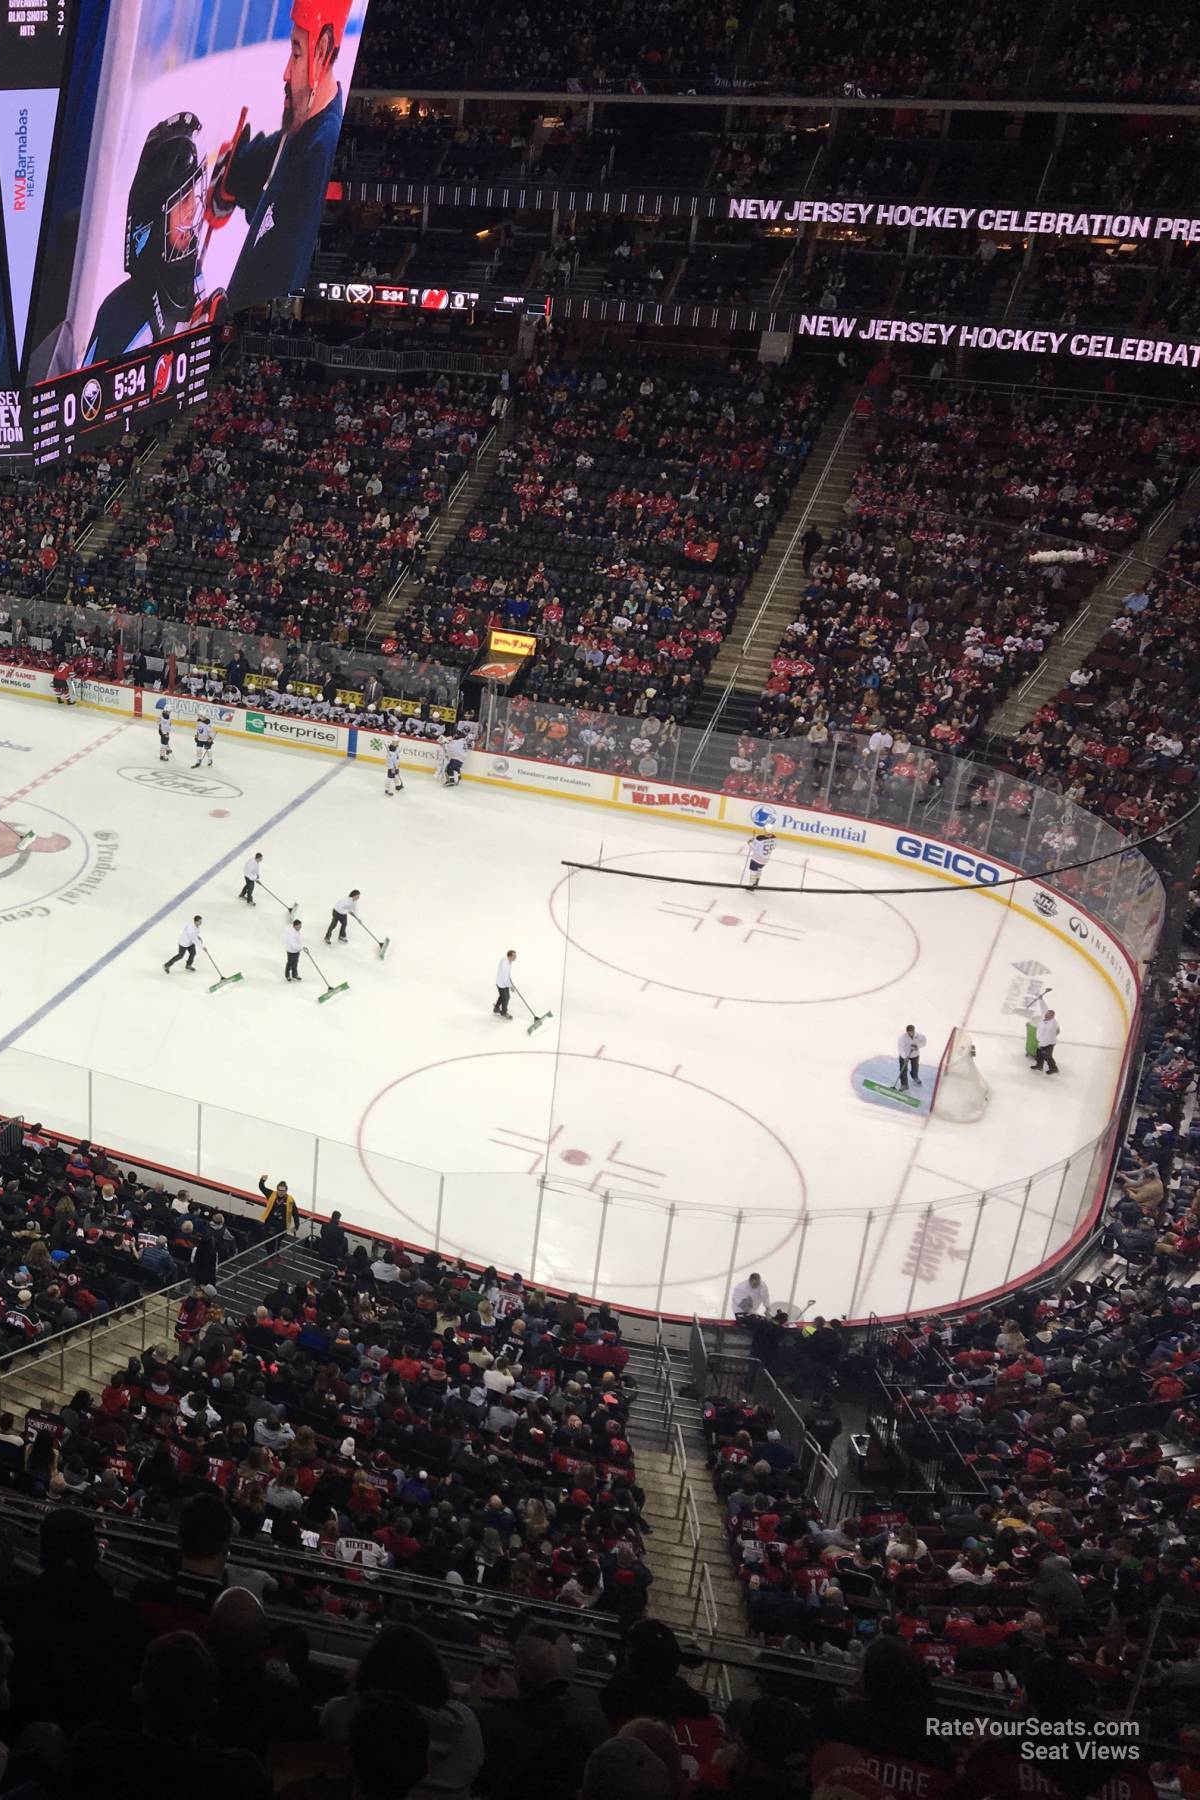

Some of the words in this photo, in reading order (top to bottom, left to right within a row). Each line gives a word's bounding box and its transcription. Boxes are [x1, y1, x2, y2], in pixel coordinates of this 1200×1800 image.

[8, 11, 26, 22] BLKD
[26, 10, 48, 22] SHOTS
[58, 11, 64, 22] 3
[20, 25, 36, 36] HITS
[57, 25, 64, 36] 7
[14, 108, 28, 211] RWJBarnabas
[26, 156, 35, 197] HEALTH
[728, 198, 782, 221] NEW
[784, 200, 874, 224] JERSEY
[877, 204, 977, 229] HOCKEY
[977, 208, 1151, 239] CELEBRATION
[332, 286, 340, 299] 0
[382, 290, 404, 302] 5:34
[455, 294, 464, 308] 0
[799, 314, 857, 339] NEW
[858, 319, 957, 346] JERSEY
[959, 325, 1068, 354] HOCKEY
[176, 353, 187, 384] 0
[114, 365, 146, 400] 5:34
[64, 393, 76, 427] 0
[125, 417, 130, 432] 1
[15, 672, 36, 680] GAMES
[94, 685, 120, 696] COAST
[252, 717, 336, 742] enterprise
[134, 771, 222, 794] Ford
[547, 774, 558, 782] and
[782, 814, 868, 844] Prudential
[896, 836, 1000, 884] GEICO
[57, 843, 119, 906] Prudential
[353, 1551, 363, 1563] 4
